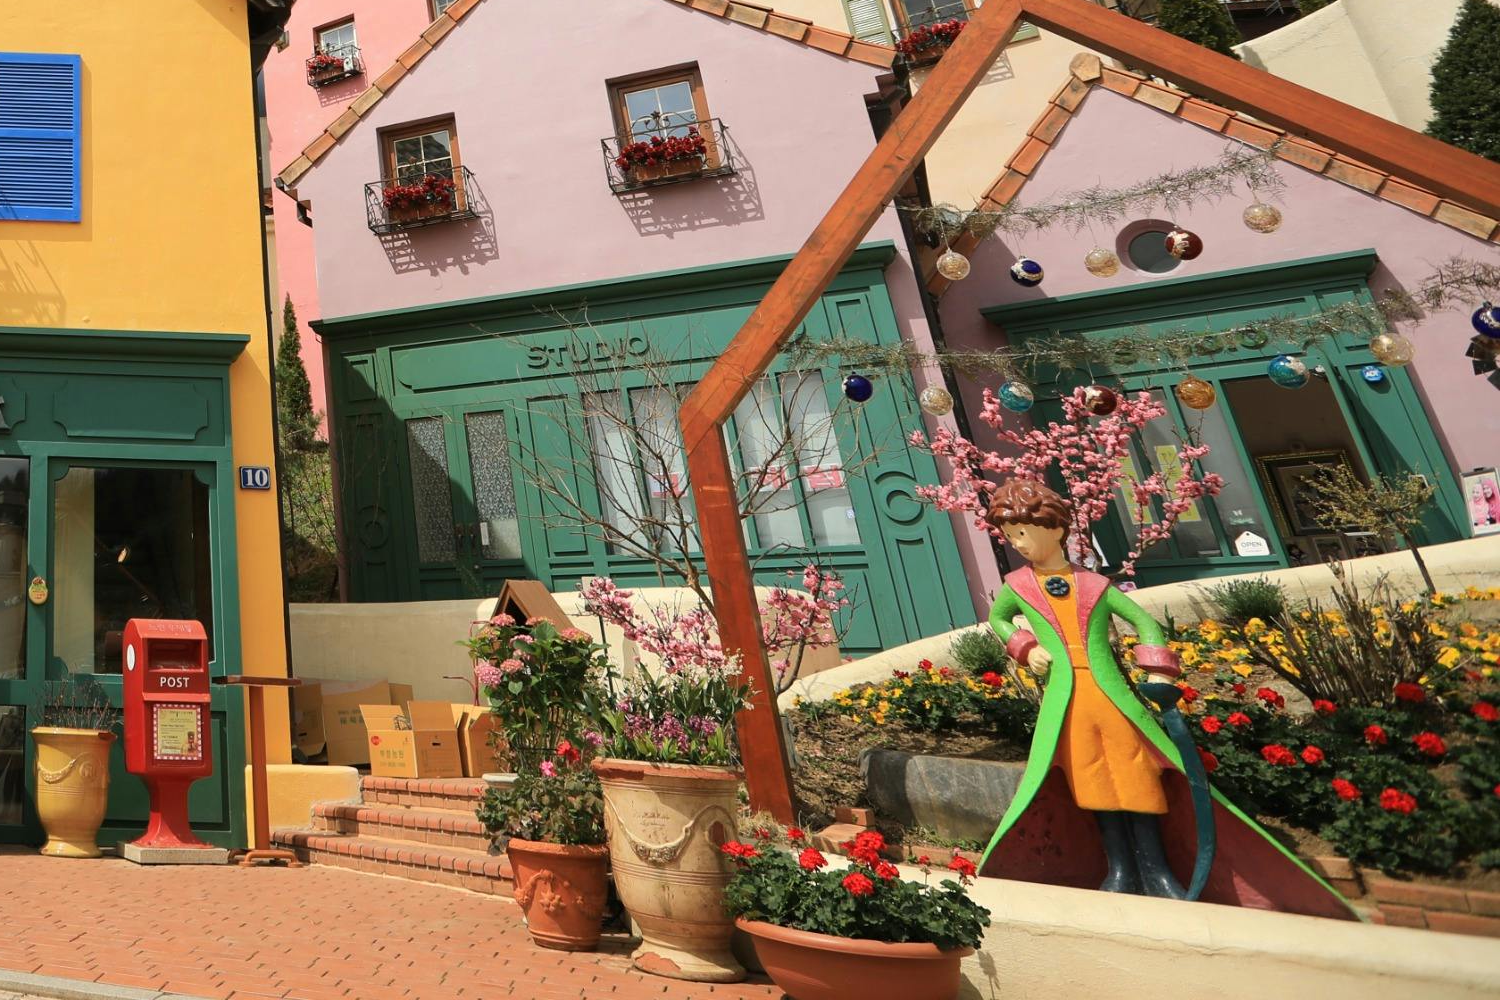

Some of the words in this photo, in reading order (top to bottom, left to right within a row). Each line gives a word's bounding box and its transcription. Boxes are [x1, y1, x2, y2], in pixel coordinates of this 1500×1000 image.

[526, 336, 650, 370] STUDIO
[244, 468, 268, 487] 10
[159, 676, 190, 688] POST
